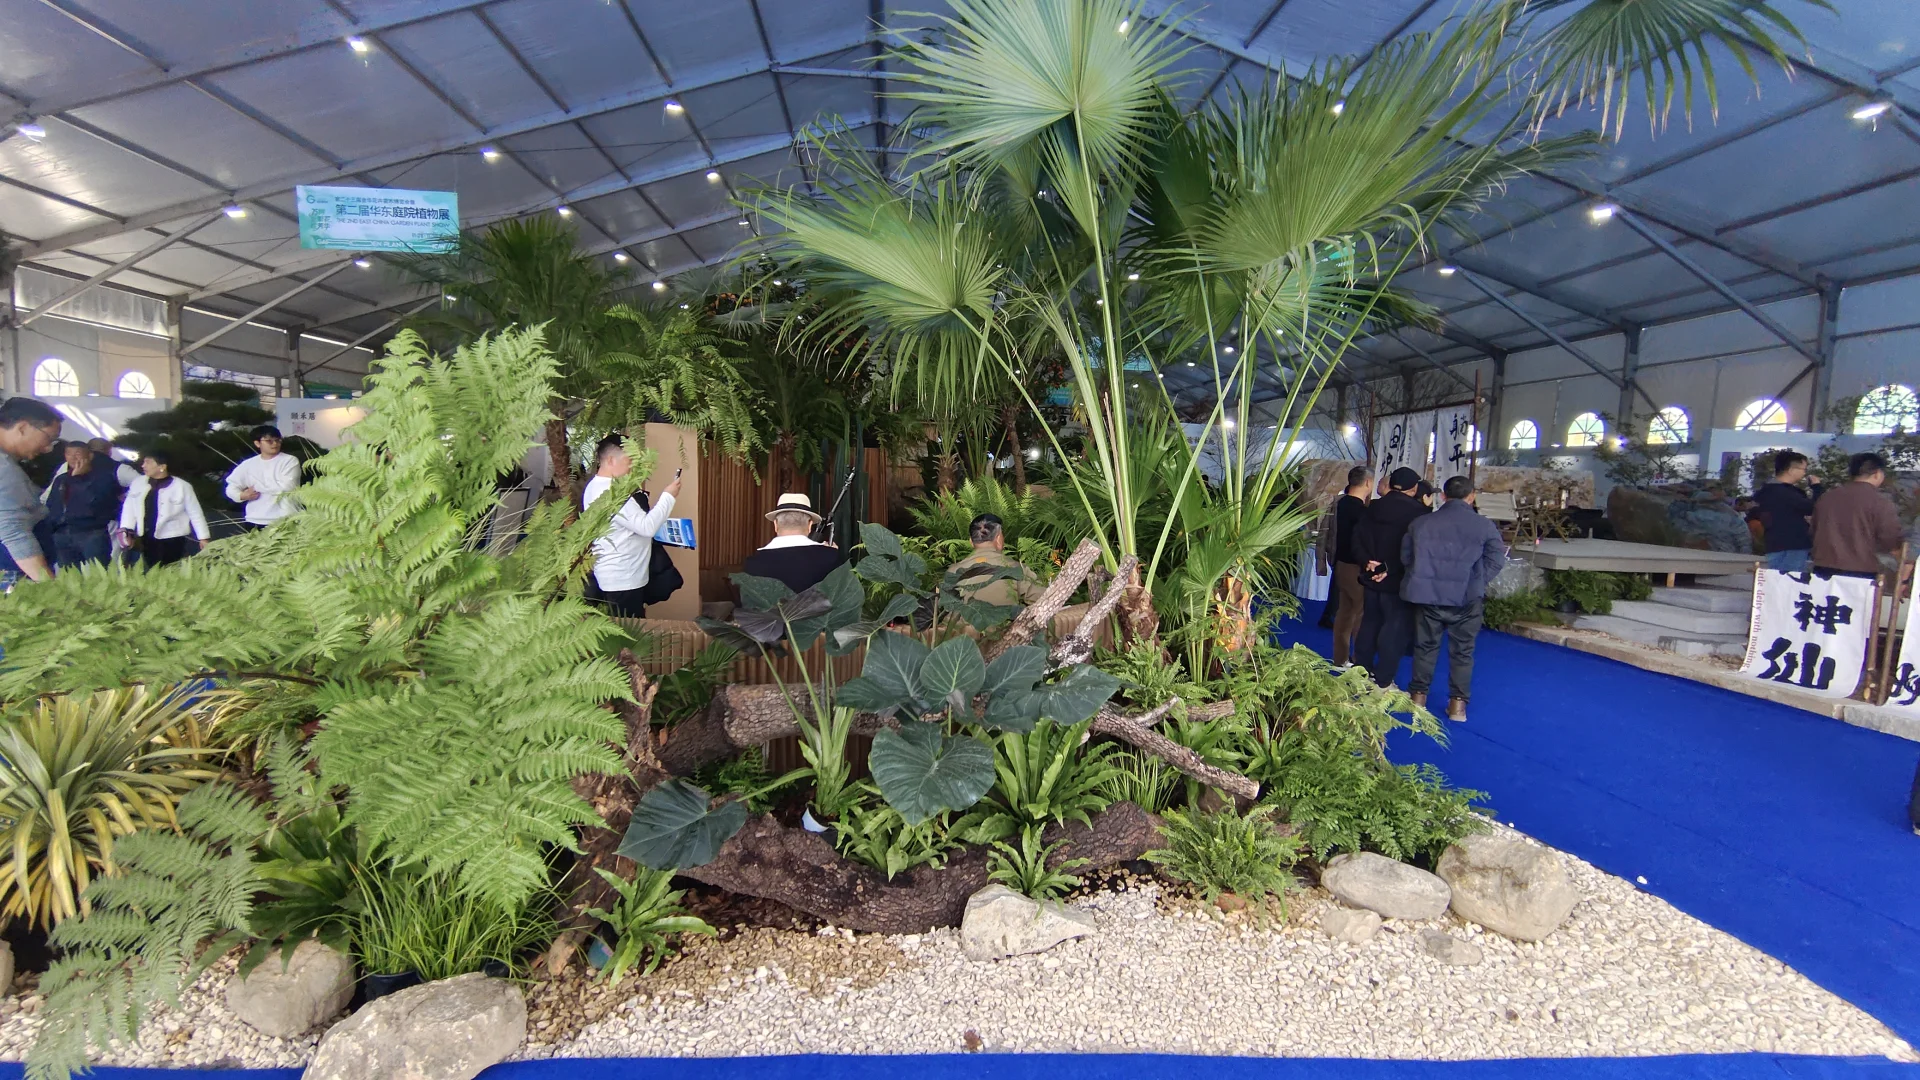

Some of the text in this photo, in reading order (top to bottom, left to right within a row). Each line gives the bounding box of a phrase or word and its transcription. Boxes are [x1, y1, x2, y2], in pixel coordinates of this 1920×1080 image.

[335, 204, 450, 220] 第二届华东庭院植物展
[1449, 413, 1469, 472] 躺平
[1742, 569, 1766, 668] ittle deity with nothing
